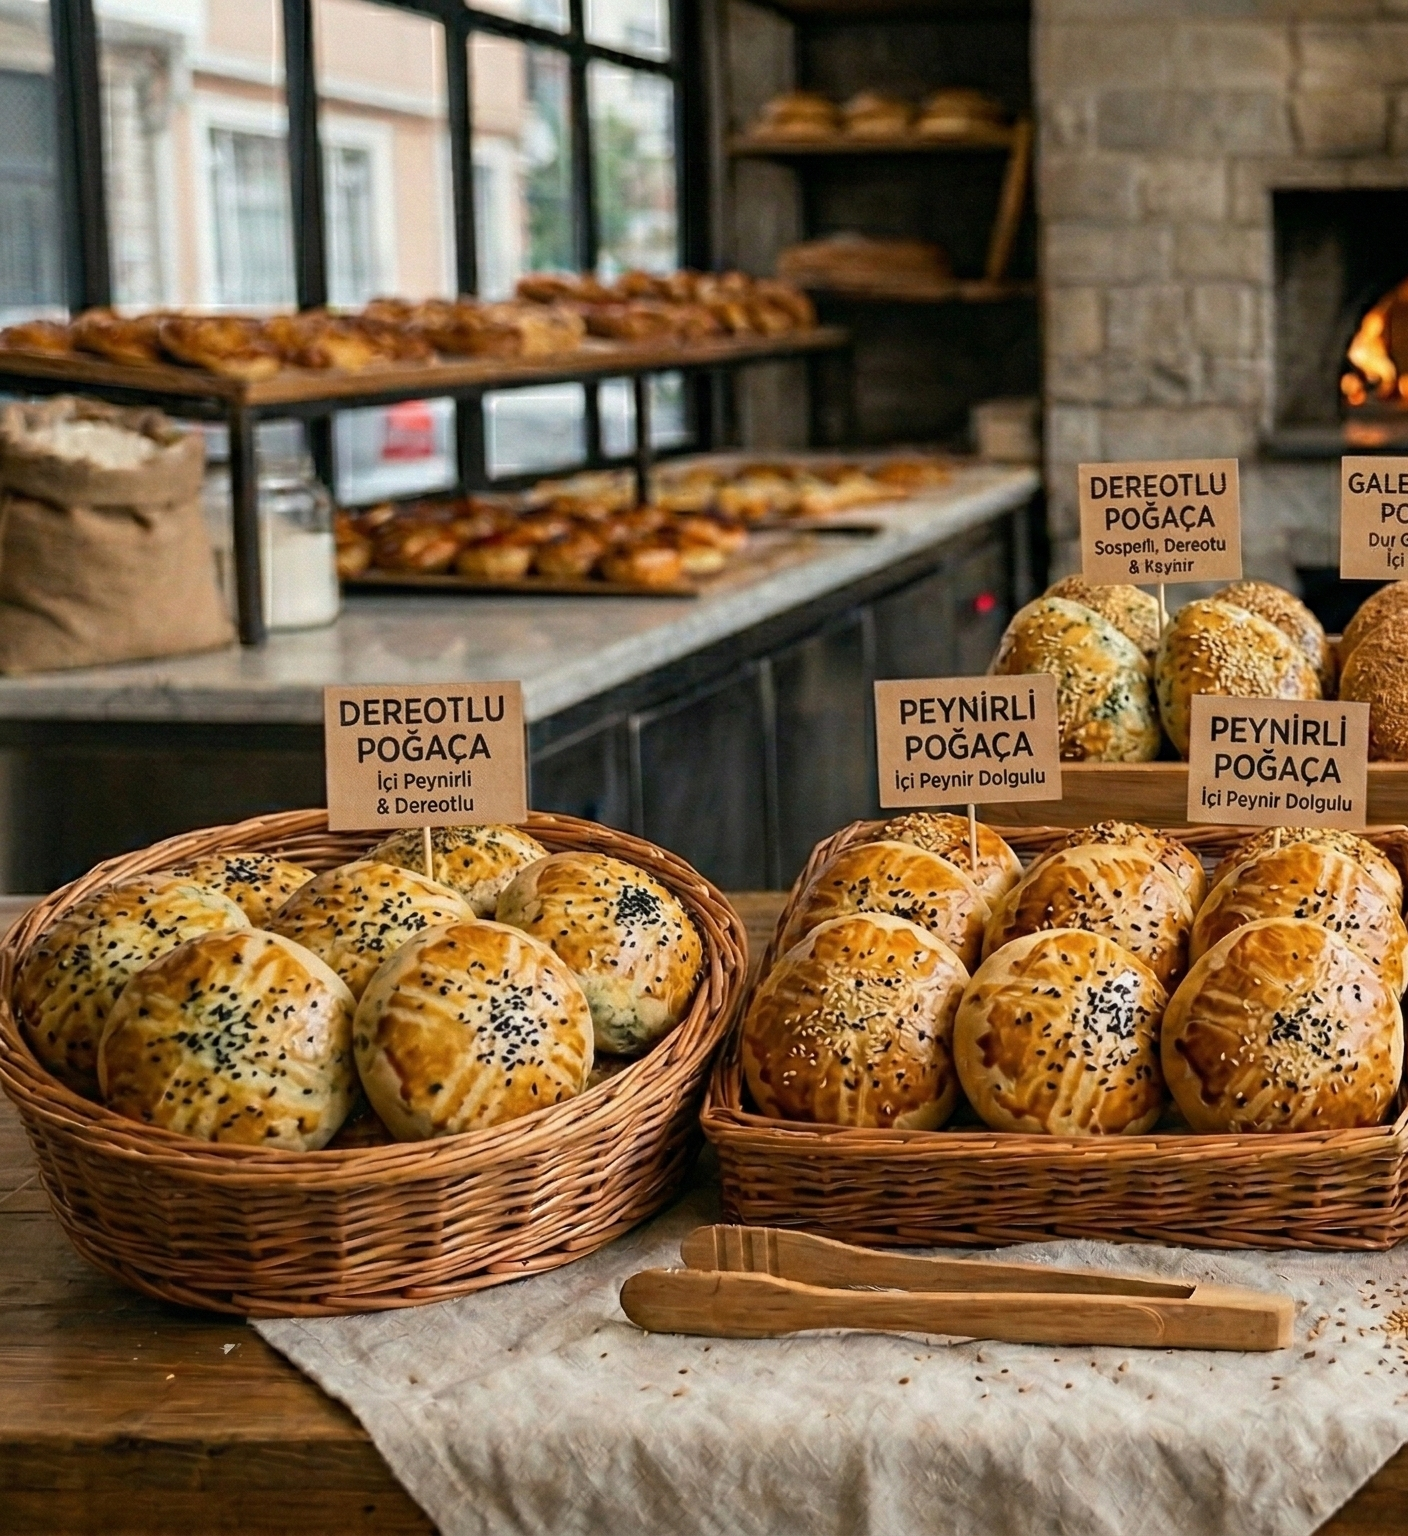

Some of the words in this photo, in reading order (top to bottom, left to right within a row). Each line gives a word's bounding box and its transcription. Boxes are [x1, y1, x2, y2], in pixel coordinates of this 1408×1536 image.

[1090, 472, 1227, 500] DEREOTLU
[1105, 501, 1216, 532] POĞAÇA
[1164, 537, 1227, 552] Dereotu
[1128, 559, 1140, 574] &
[339, 695, 505, 727] DEREOTLU
[900, 688, 1036, 725] PEYNİRLİ
[1210, 713, 1346, 747] PEYNİRLİ
[357, 728, 492, 765] POĞAÇA
[905, 727, 1034, 763] POĞAÇA
[377, 770, 398, 793] İçi
[404, 770, 472, 792] Peynirli
[895, 770, 915, 792] İçi
[920, 770, 974, 791] Peynir
[979, 768, 1045, 788] Dolgulu
[1214, 748, 1342, 787] POĞAÇA
[376, 798, 390, 815] &
[395, 795, 474, 814] Dereotlu
[1201, 786, 1221, 809] İçi
[1226, 790, 1280, 811] Peynir
[1285, 793, 1352, 814] Dolgulu
